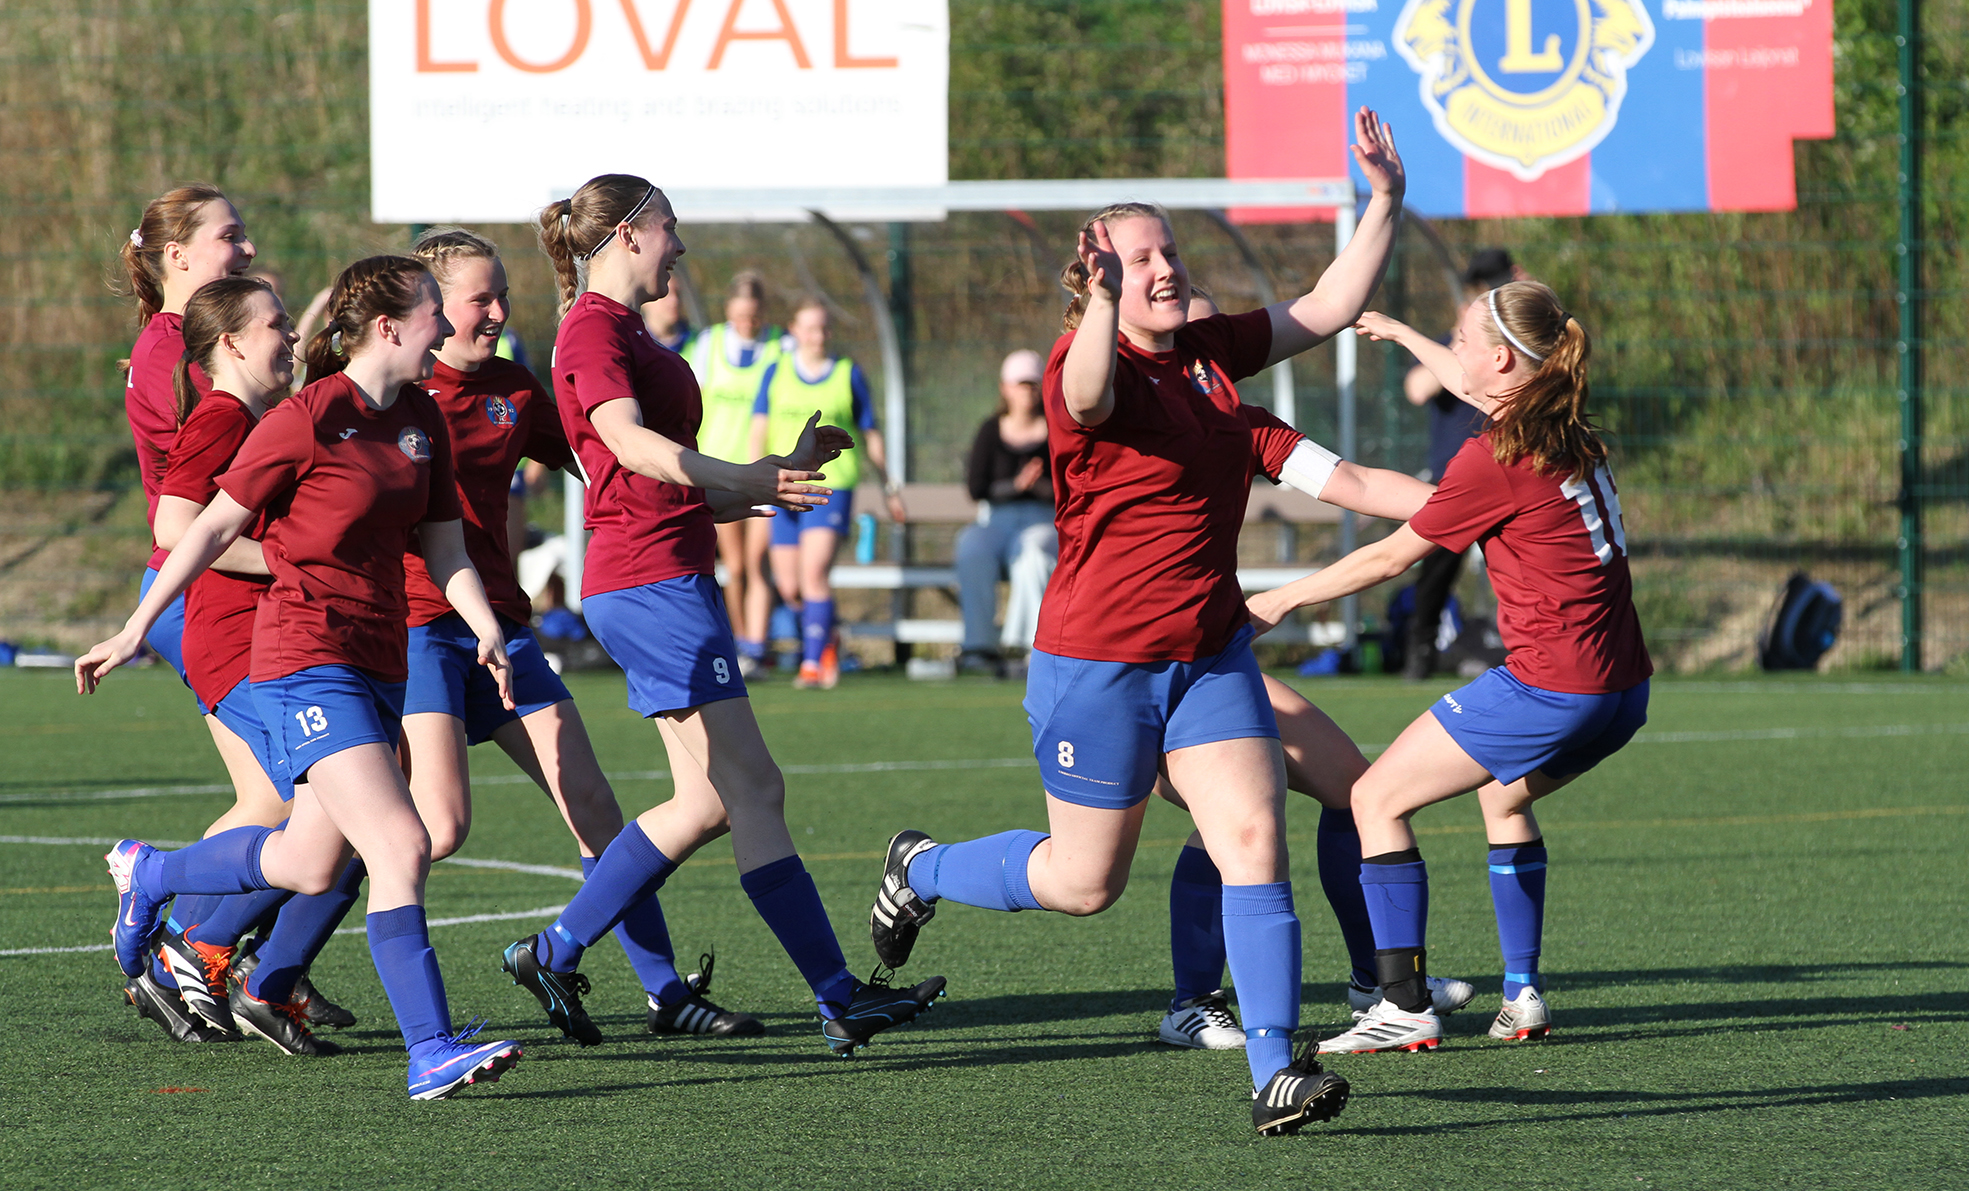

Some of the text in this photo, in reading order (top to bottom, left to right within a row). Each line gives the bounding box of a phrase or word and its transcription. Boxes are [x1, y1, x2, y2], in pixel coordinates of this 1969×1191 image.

[414, 0, 900, 74] LOVAL
[1499, 0, 1564, 73] L
[713, 657, 730, 684] 9
[295, 705, 328, 737] 13
[1058, 740, 1075, 768] 8
